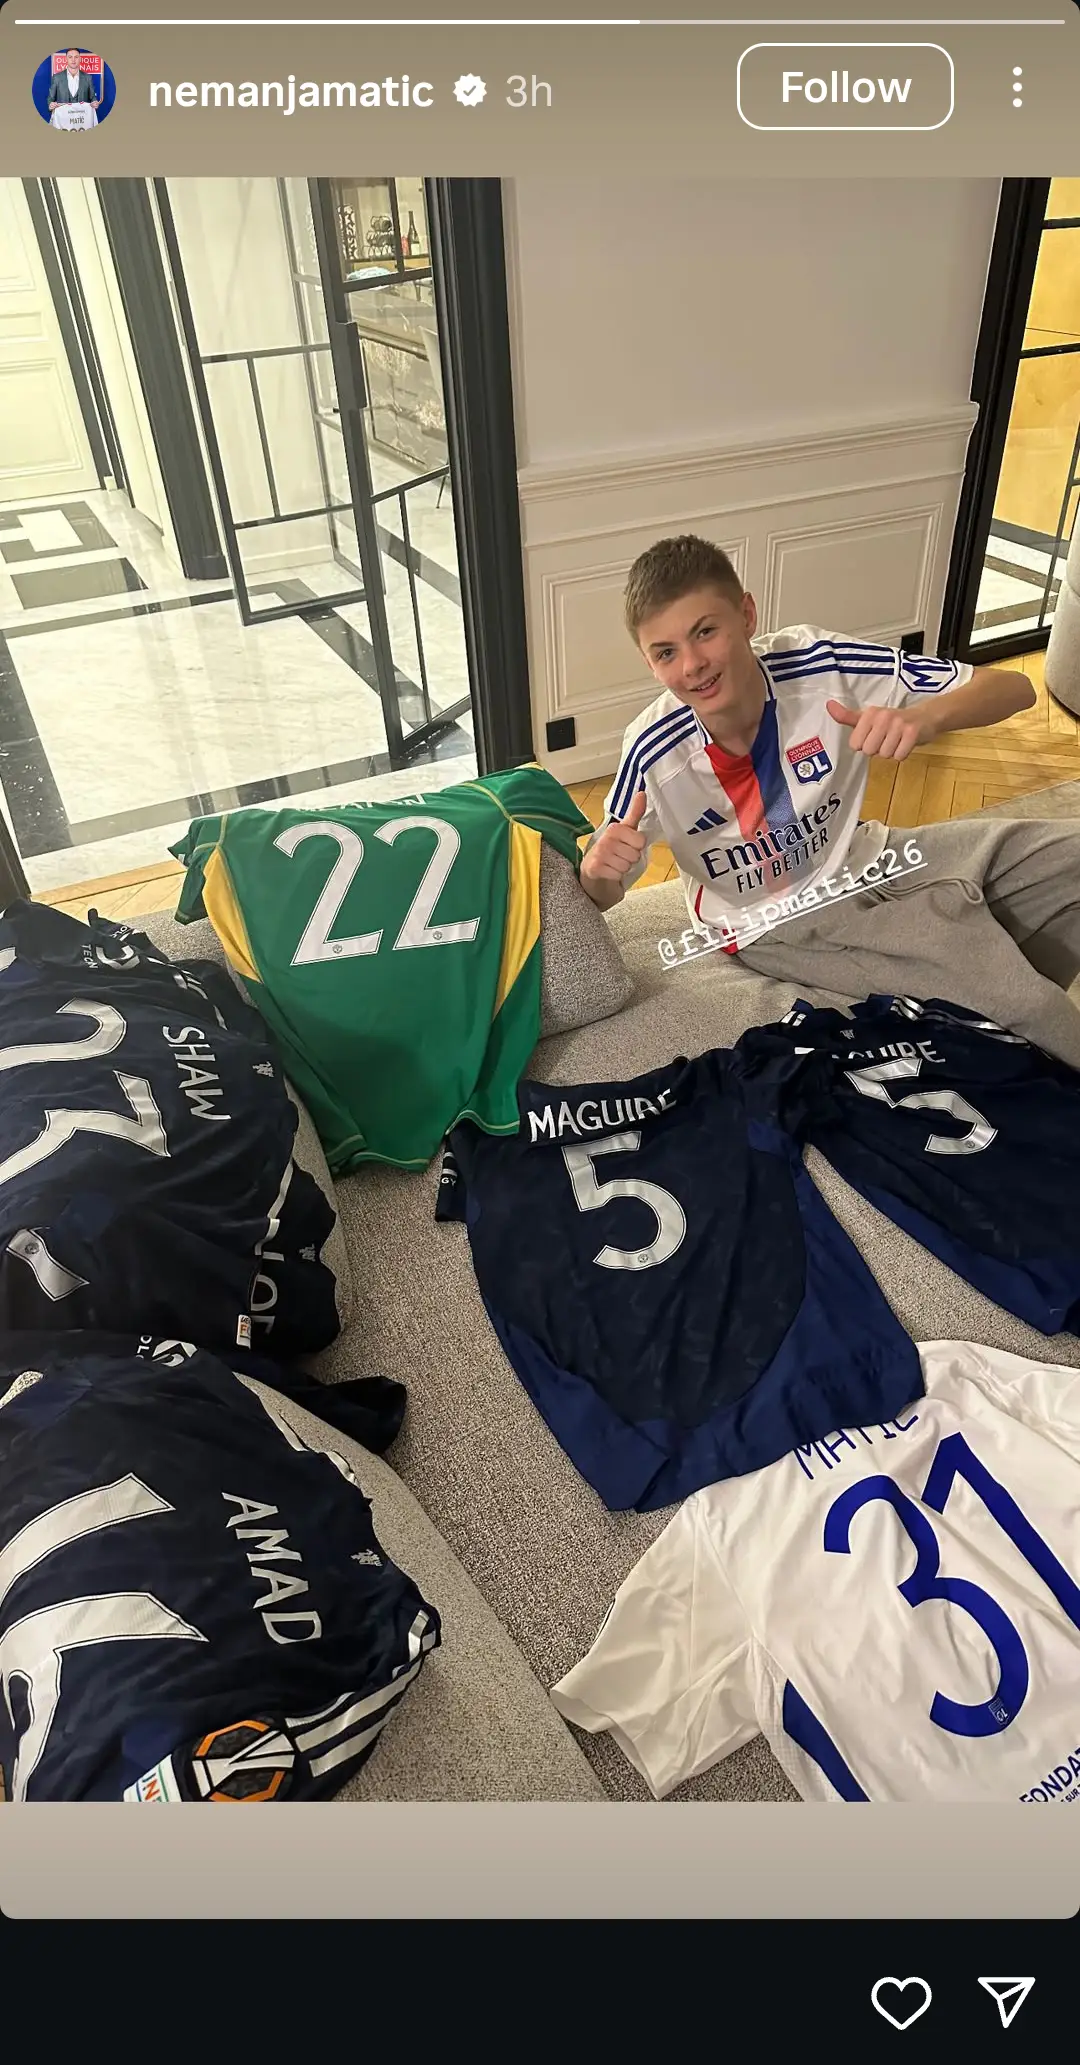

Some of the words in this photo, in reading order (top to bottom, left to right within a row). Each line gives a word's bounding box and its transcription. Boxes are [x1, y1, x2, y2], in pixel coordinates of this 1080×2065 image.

[273, 816, 481, 966] 22
[700, 793, 841, 880] Emirates
[736, 867, 763, 893] FLY
[771, 827, 829, 878] BETTER
[162, 1025, 231, 1120] SHAW
[843, 1056, 998, 1155] 5
[561, 1130, 687, 1271] 5
[221, 1492, 322, 1645] AMAD
[823, 1432, 1080, 1738] 31
